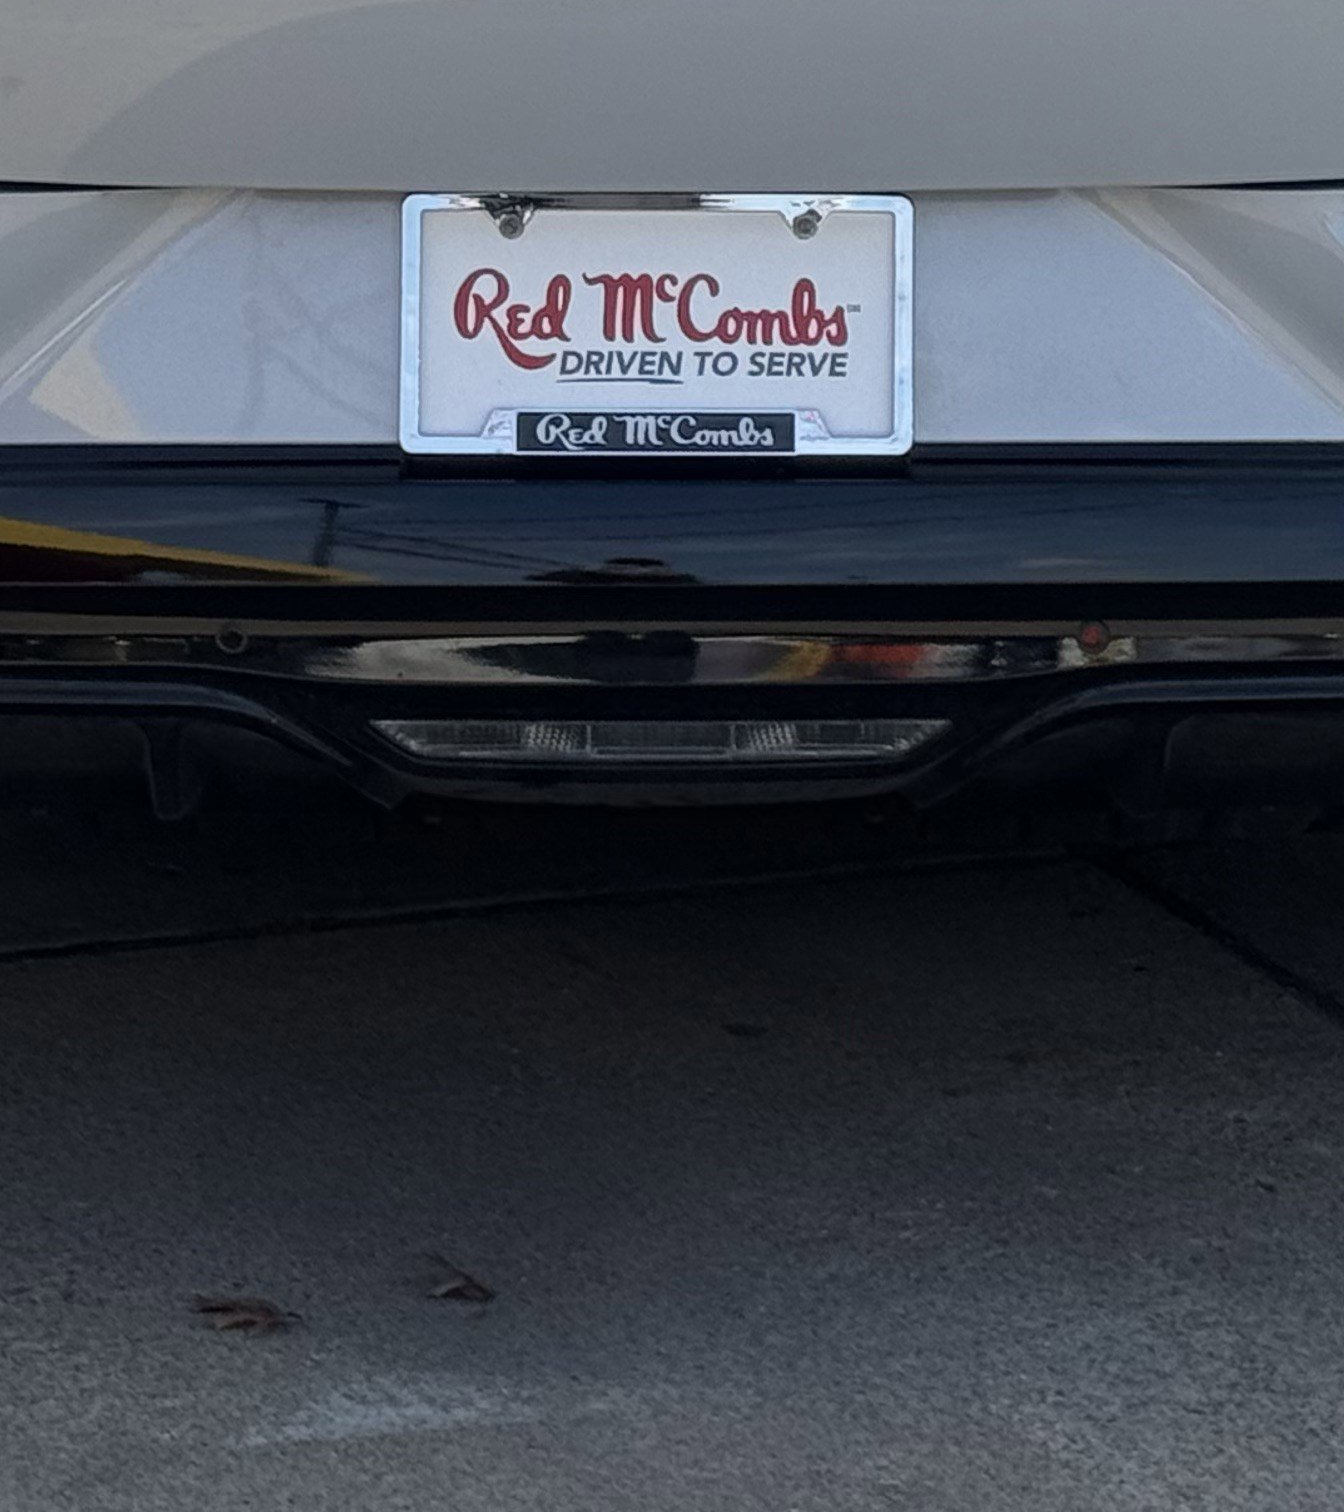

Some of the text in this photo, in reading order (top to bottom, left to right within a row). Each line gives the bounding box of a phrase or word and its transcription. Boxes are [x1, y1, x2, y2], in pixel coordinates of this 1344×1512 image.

[453, 267, 849, 370] Red McCombs
[558, 350, 850, 378] DRIVEN TO SERVE
[536, 412, 775, 451] Red McCombs
